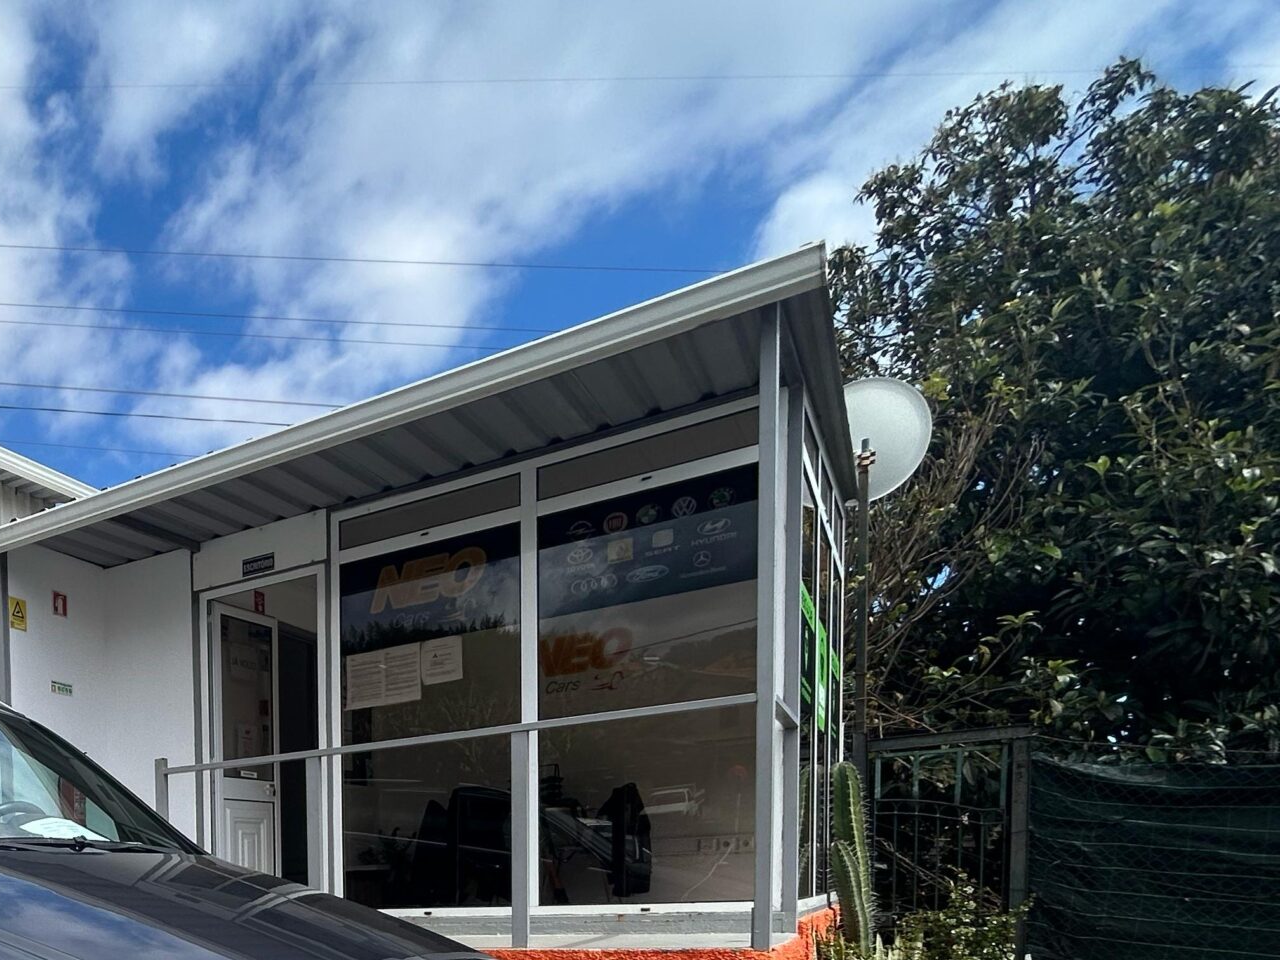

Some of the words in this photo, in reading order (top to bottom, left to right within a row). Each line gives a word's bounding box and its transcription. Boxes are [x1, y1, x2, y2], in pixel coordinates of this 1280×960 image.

[691, 532, 737, 547] HYUNDAI
[645, 545, 681, 557] SEAT
[370, 546, 487, 614] NEO
[393, 612, 430, 629] Cars
[545, 680, 580, 695] Cars
